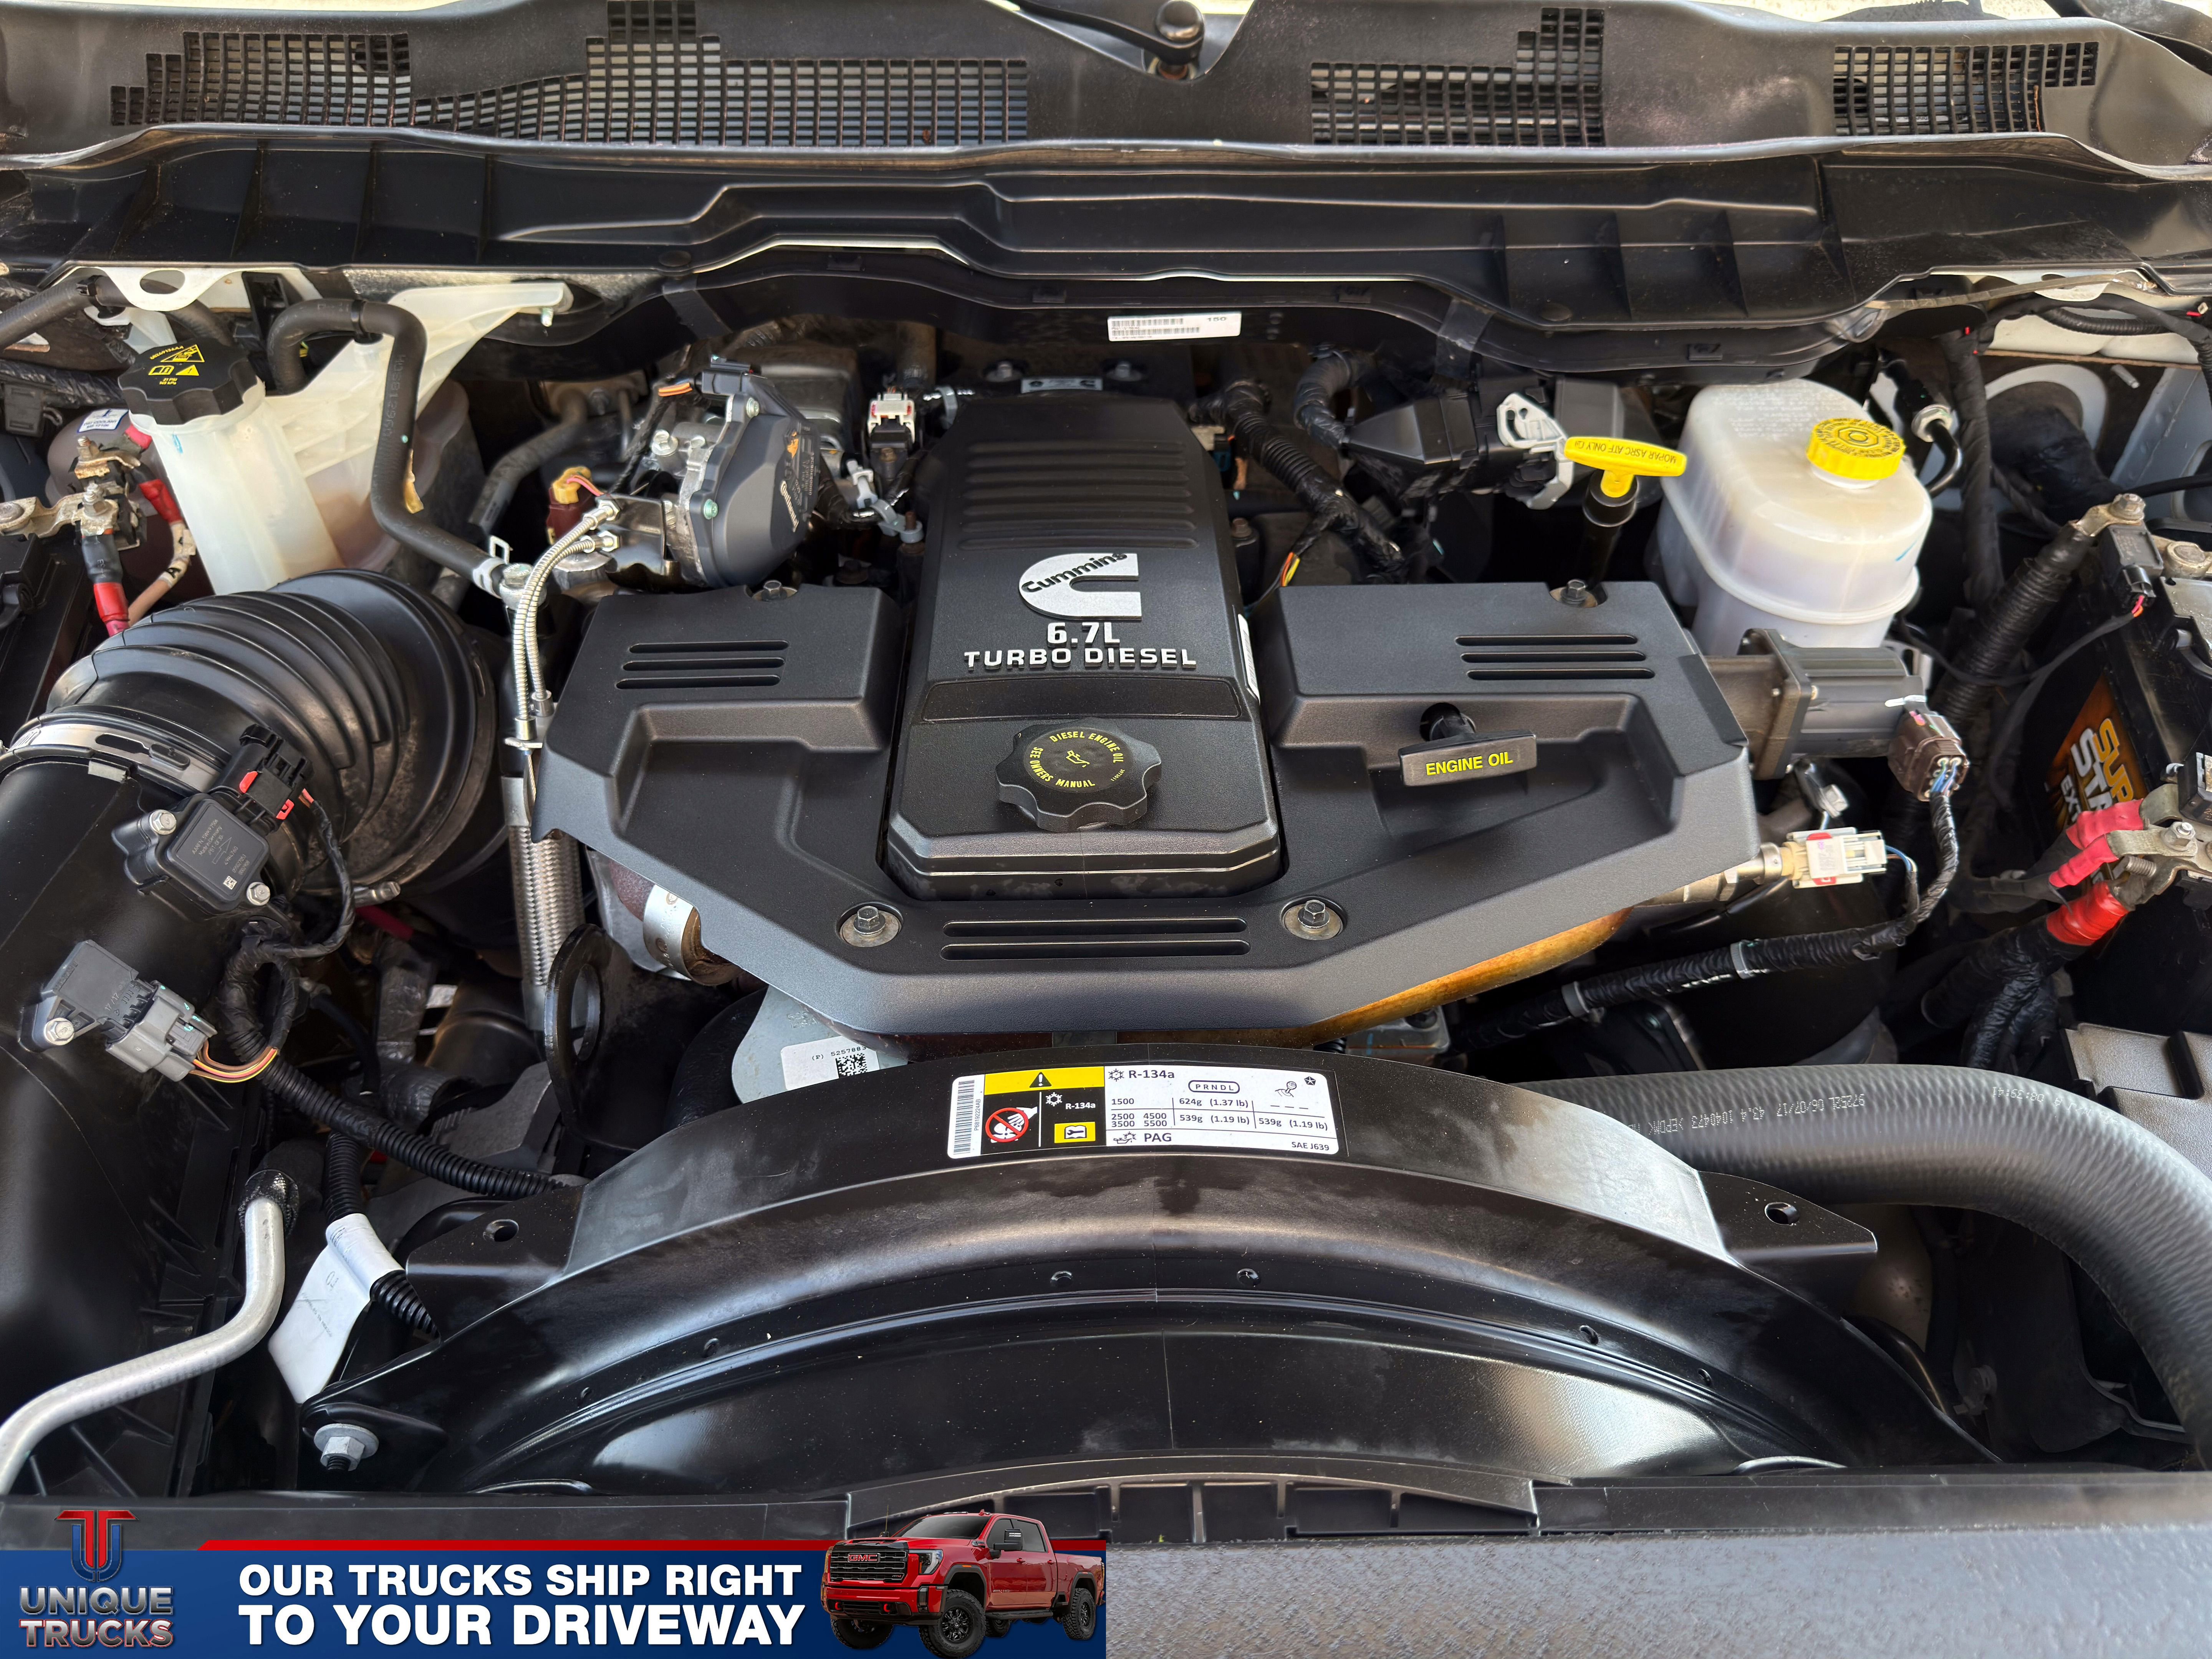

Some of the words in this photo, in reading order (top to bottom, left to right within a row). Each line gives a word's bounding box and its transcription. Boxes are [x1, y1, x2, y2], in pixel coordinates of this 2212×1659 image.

[1586, 442, 1606, 452] ONLY
[1608, 445, 1623, 454] ATF
[1625, 448, 1646, 457] ASRC
[1649, 452, 1677, 464] MOPAR
[781, 480, 799, 532] Continental
[1021, 553, 1128, 593] Cummins
[1047, 622, 1121, 647] 6.7L
[964, 648, 1072, 671] TURBO
[1084, 647, 1197, 669] DIESEL
[1030, 747, 1044, 758] SEE
[1049, 731, 1085, 742] DIESEL
[1088, 733, 1119, 752] ENGINE
[1113, 753, 1124, 763] OIL
[1030, 760, 1054, 782] OWNERS
[1426, 755, 1483, 775] ENGINE
[1488, 752, 1513, 767] OIL
[1055, 778, 1095, 788] MANUAL
[199, 846, 208, 857] Made
[210, 826, 223, 843] Germany
[1129, 1070, 1175, 1079] R-134a
[1179, 1098, 1202, 1106] 624g
[1210, 1098, 1233, 1107] (1.37
[1237, 1099, 1248, 1108] lb)
[1992, 1086, 2045, 1103] 08:39:41
[1740, 1106, 1765, 1122] 43.4
[1777, 1098, 1824, 1117] 06/07/17
[1180, 1114, 1203, 1123] 539g
[1211, 1115, 1234, 1124] (1.19
[1238, 1116, 1249, 1125] lb)
[1259, 1118, 1282, 1127] 539g
[1290, 1119, 1313, 1128] (1.19
[1316, 1122, 1328, 1131] lb)
[1691, 1109, 1733, 1129] 1040473
[1144, 1132, 1172, 1142] PAG
[1310, 1143, 1330, 1151] J639
